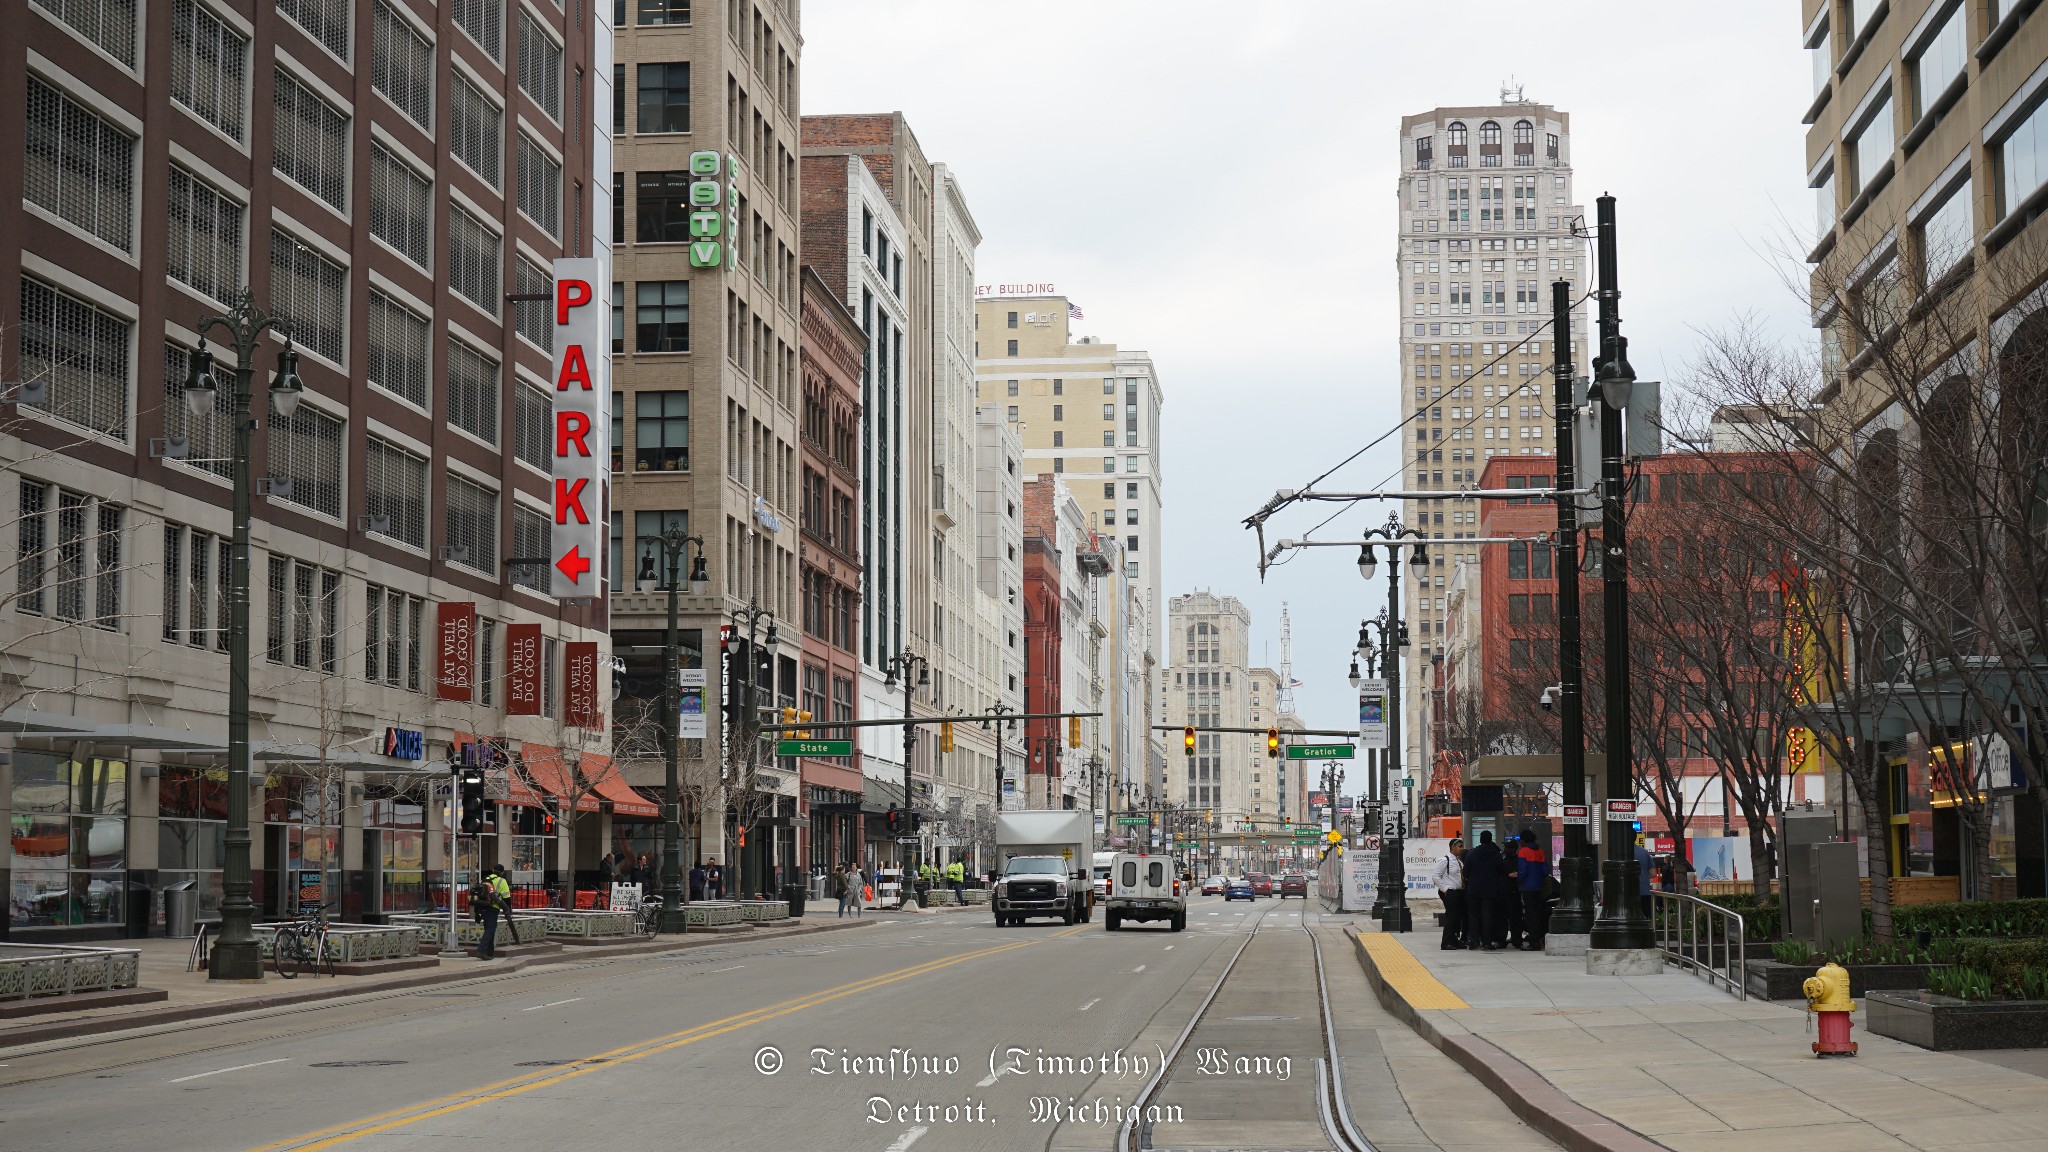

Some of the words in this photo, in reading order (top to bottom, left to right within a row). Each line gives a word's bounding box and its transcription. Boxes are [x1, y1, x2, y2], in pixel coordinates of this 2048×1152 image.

[692, 154, 718, 263] GSTV
[1000, 283, 1055, 294] BUILDING
[1025, 311, 1057, 323] aloft
[555, 279, 593, 525] PARK
[444, 619, 456, 656] WELL
[457, 615, 468, 661] GOOD.
[513, 639, 523, 676] WELL
[525, 636, 535, 678] GOOD.
[444, 661, 455, 686] EAT
[457, 665, 468, 688] DO
[572, 656, 581, 689] WELL
[583, 653, 592, 692] GOOD.
[722, 652, 730, 706] UNDER
[513, 677, 523, 700] EAT
[525, 682, 534, 702] DO
[572, 692, 581, 713] EAT
[583, 695, 591, 714] DO
[396, 728, 422, 760] SLICES
[800, 743, 828, 752] State
[1304, 748, 1337, 756] Gratiot
[1393, 779, 1401, 802] QLINE
[1384, 822, 1407, 836] 25
